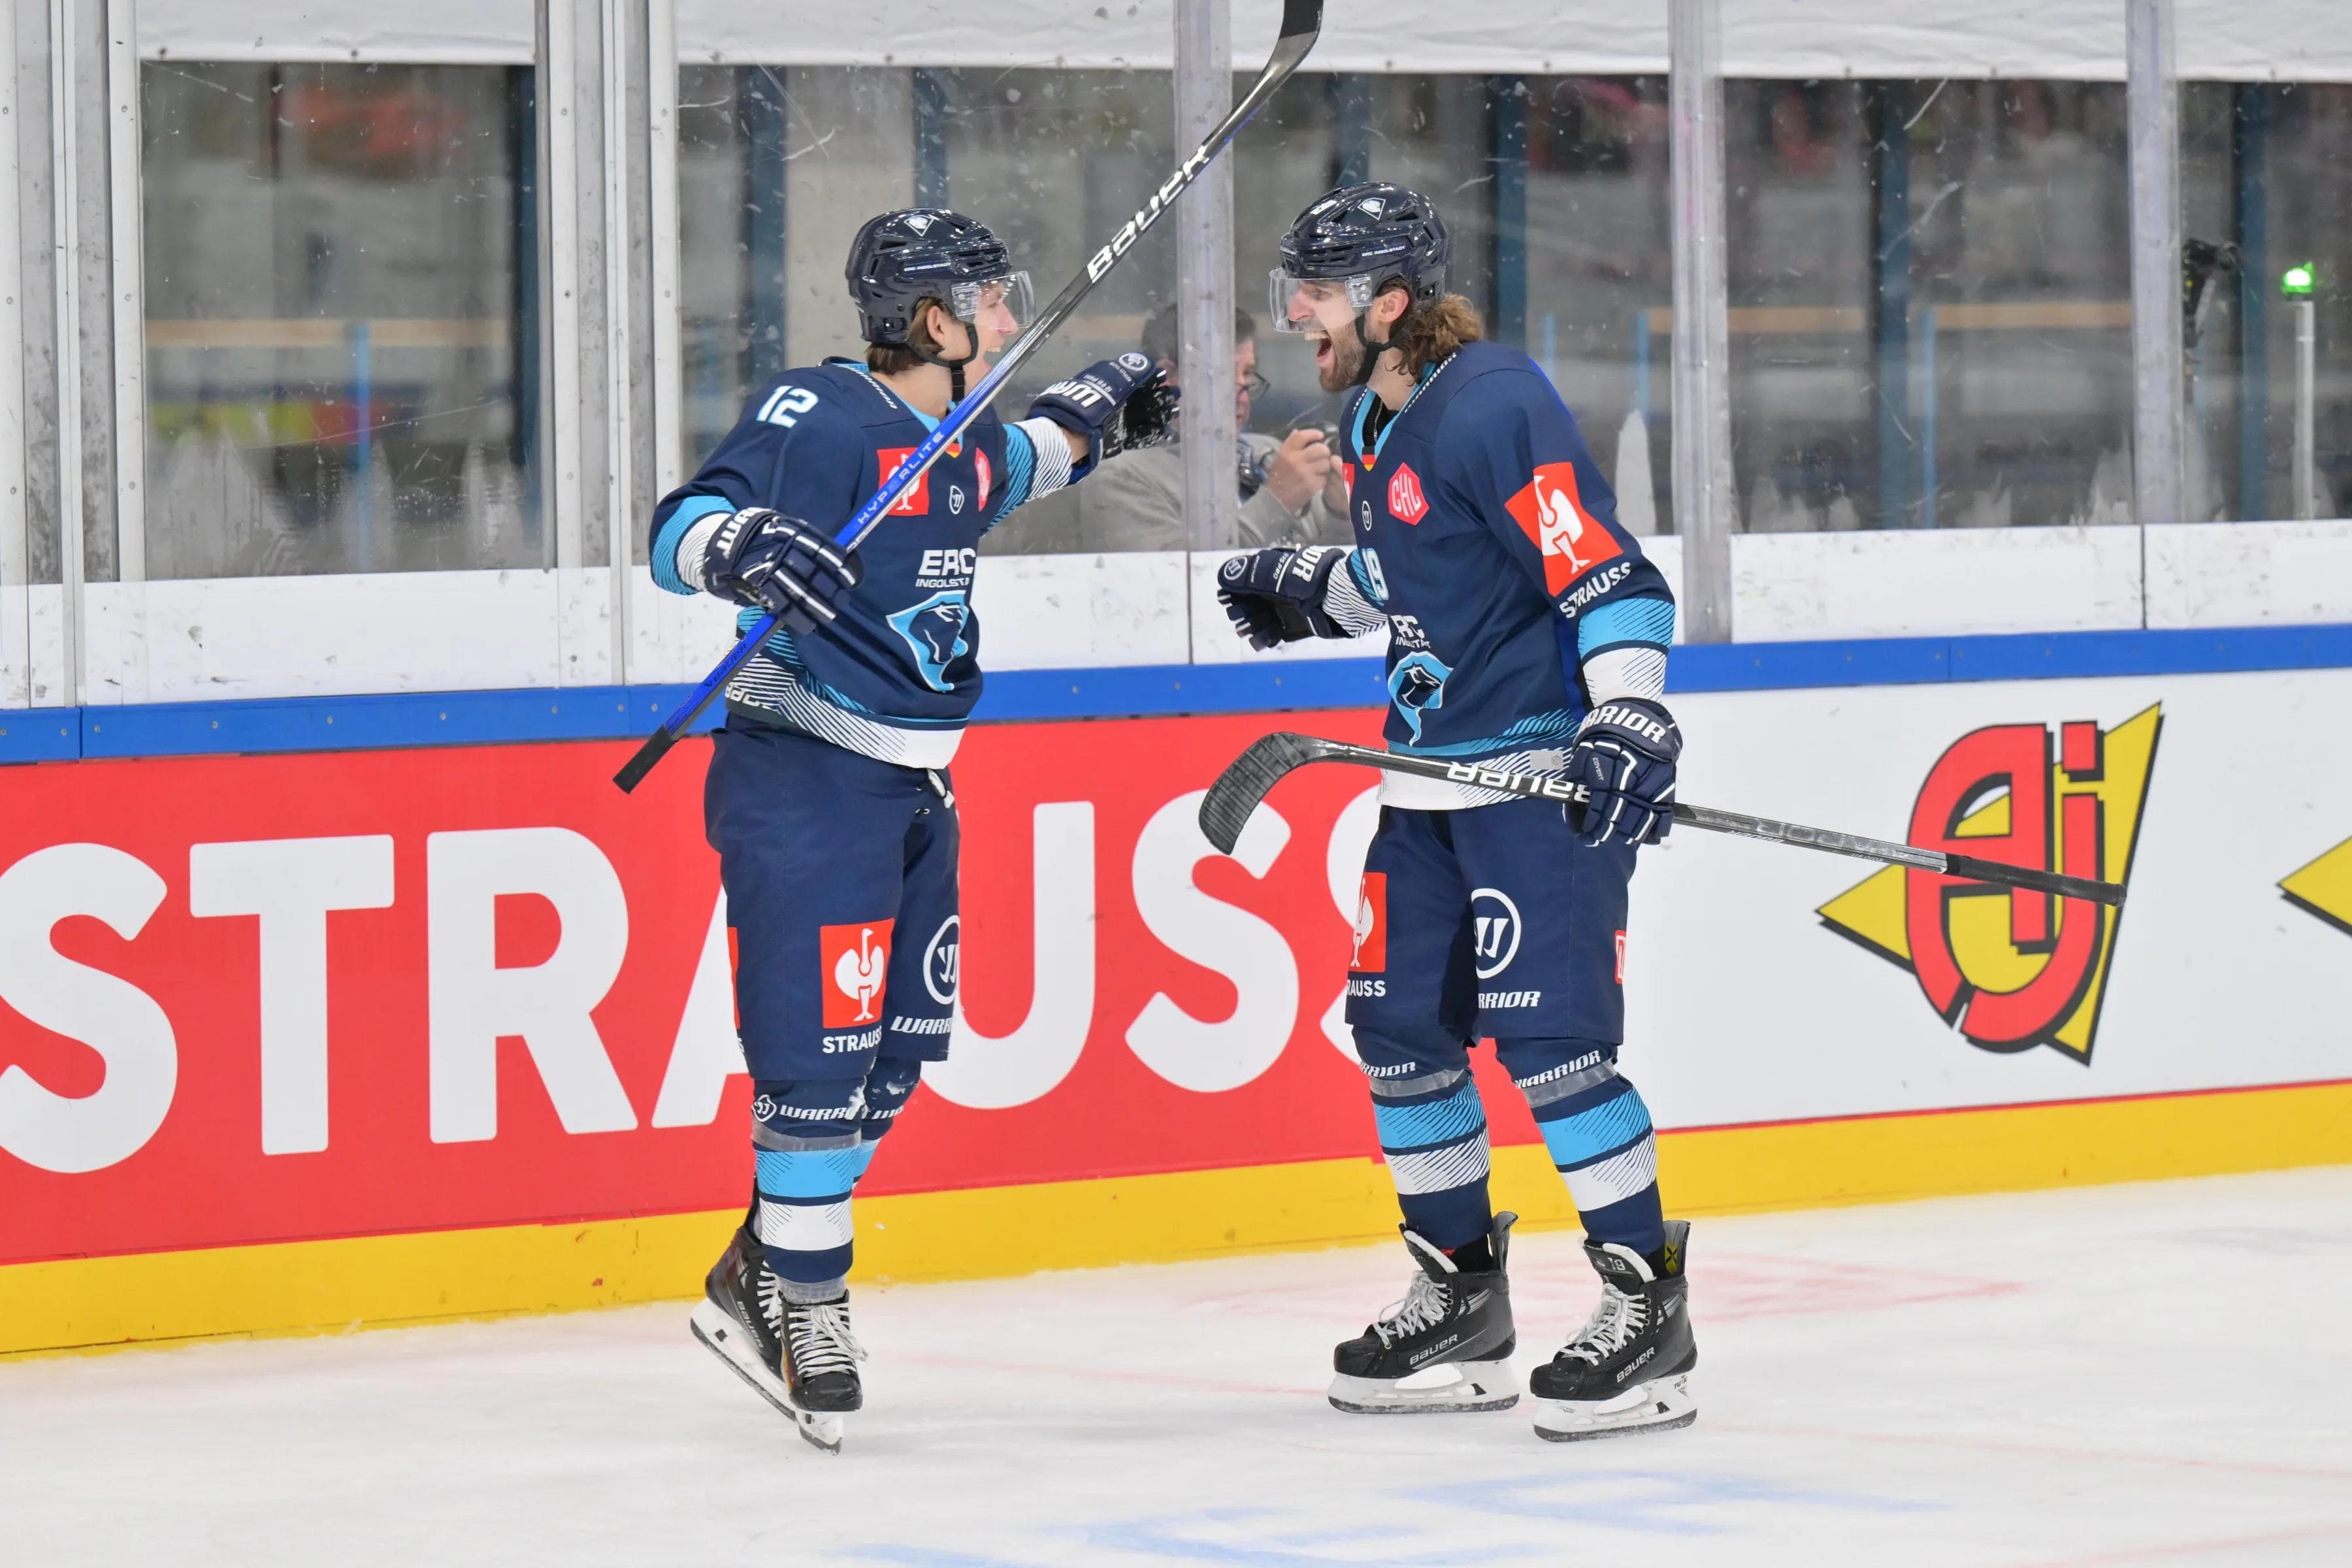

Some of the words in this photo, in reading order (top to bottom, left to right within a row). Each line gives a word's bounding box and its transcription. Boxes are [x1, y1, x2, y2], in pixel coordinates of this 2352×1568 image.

[1087, 144, 1210, 284] BAUER
[757, 385, 819, 429] 12
[1392, 473, 1422, 517] CHL
[918, 547, 976, 576] ERC
[1559, 562, 1631, 618] STRAUSS
[1592, 757, 1604, 781] COVERT
[737, 1301, 764, 1348] BAUER
[1410, 1334, 1458, 1365] BAUER
[1616, 1347, 1656, 1383] BAUER
